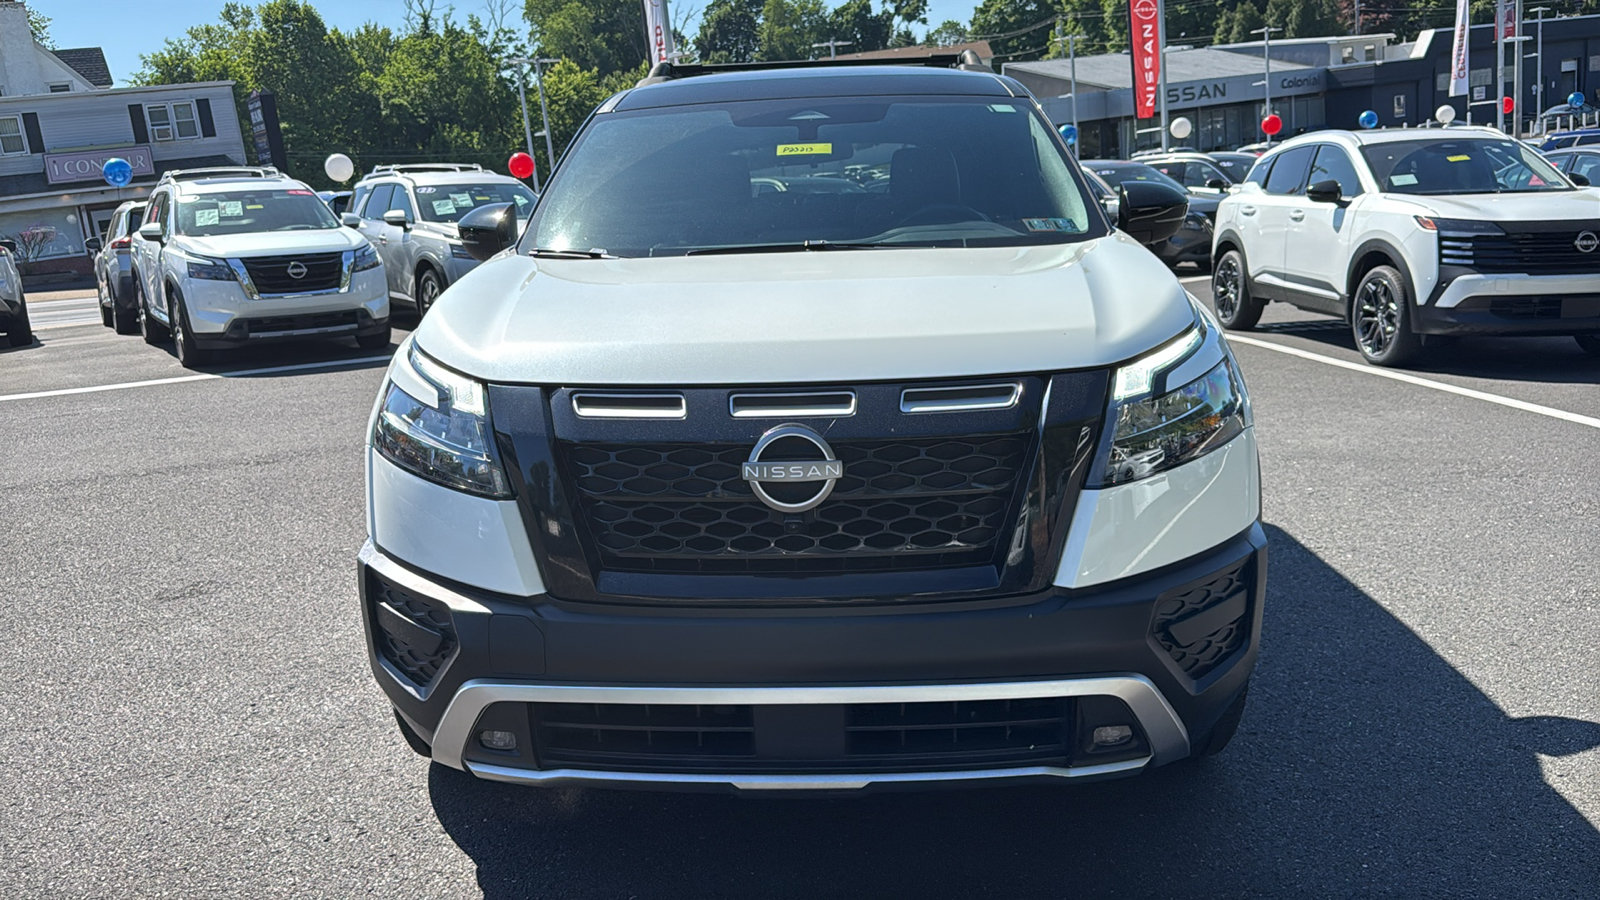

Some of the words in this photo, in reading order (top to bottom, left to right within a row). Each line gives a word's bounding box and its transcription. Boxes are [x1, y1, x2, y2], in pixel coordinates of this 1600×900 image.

[1142, 24, 1155, 107] NISSAN
[1166, 82, 1227, 104] SSAN
[63, 155, 146, 175] CONUR
[745, 464, 840, 478] NISSAN
